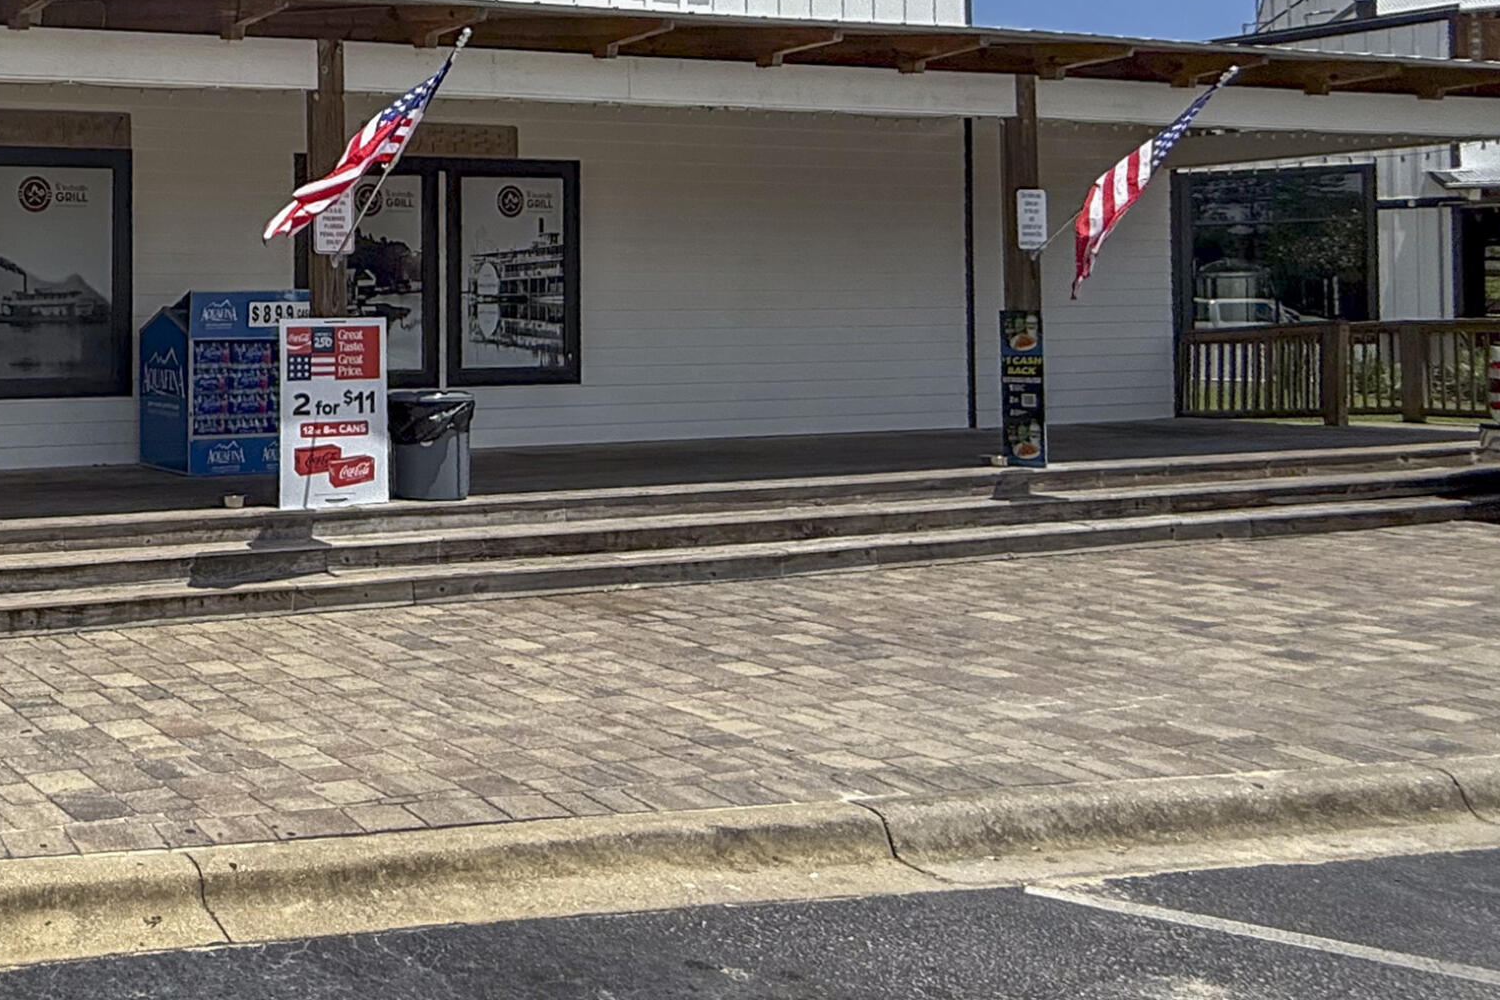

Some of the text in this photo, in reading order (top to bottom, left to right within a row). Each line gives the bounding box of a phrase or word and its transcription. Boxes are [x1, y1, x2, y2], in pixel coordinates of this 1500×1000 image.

[55, 192, 88, 202] GRILL
[338, 329, 363, 341] Great
[338, 341, 364, 352] Taste.
[338, 354, 363, 365] Great
[338, 366, 363, 377] Price.
[293, 389, 375, 416] 2 for $11
[339, 423, 366, 433] CANS
